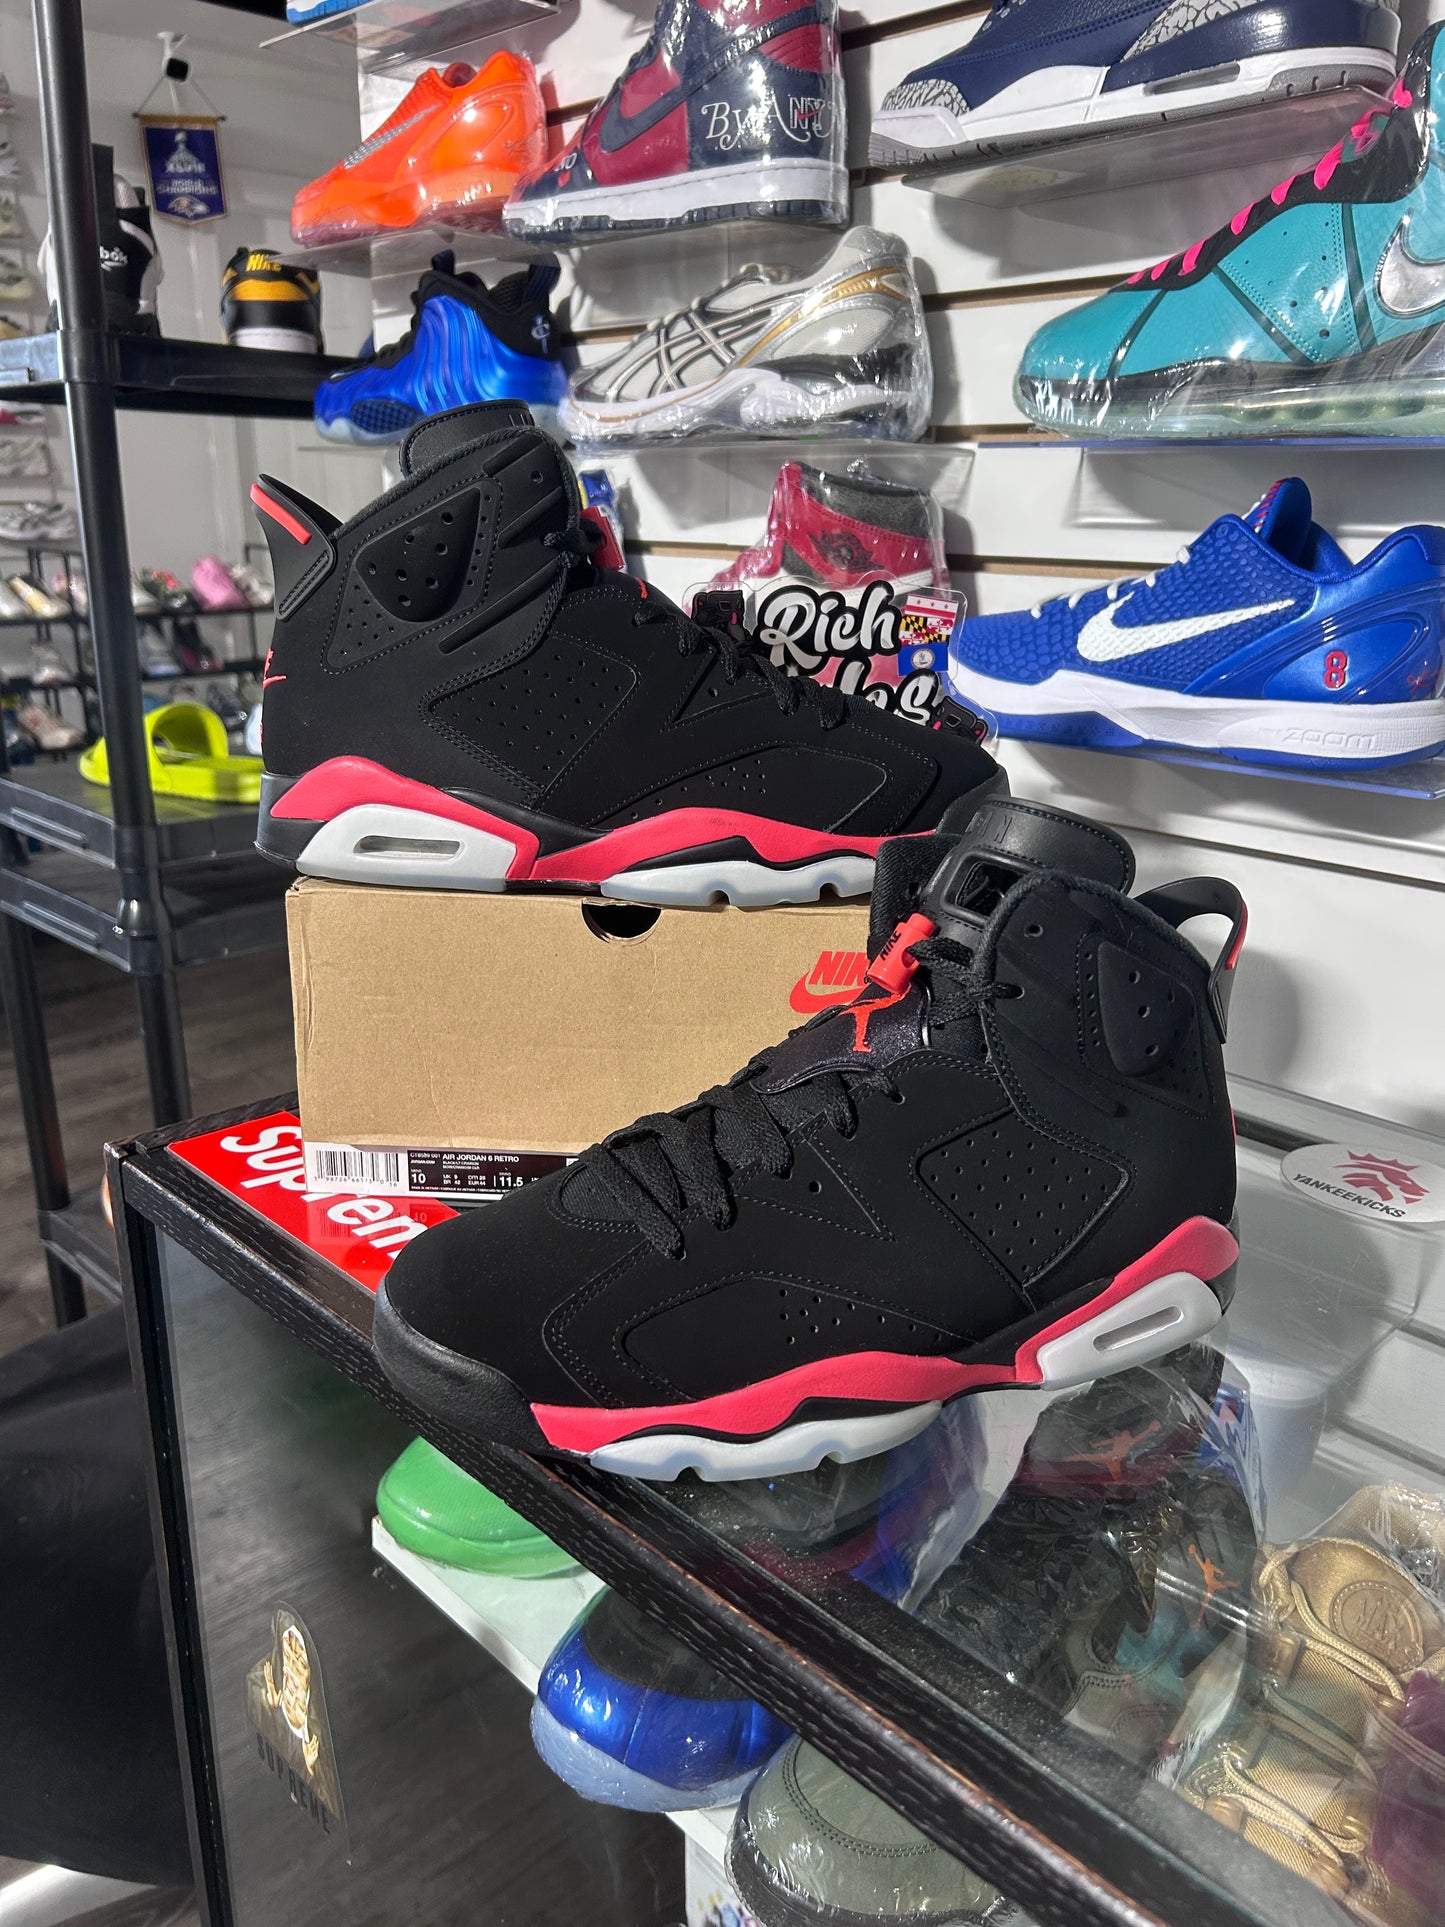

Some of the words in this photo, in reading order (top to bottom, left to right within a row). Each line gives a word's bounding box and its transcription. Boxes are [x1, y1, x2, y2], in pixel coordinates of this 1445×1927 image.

[760, 584, 895, 670] Rich
[1323, 650, 1349, 691] 8
[880, 930, 902, 961] NIKE
[808, 951, 870, 986] NIK
[494, 1155, 520, 1163] RETRO
[220, 1125, 428, 1260] Supem
[411, 1172, 426, 1184] 10
[499, 1176, 524, 1187] 11.5
[1293, 1172, 1407, 1219] YANKEEKICKS
